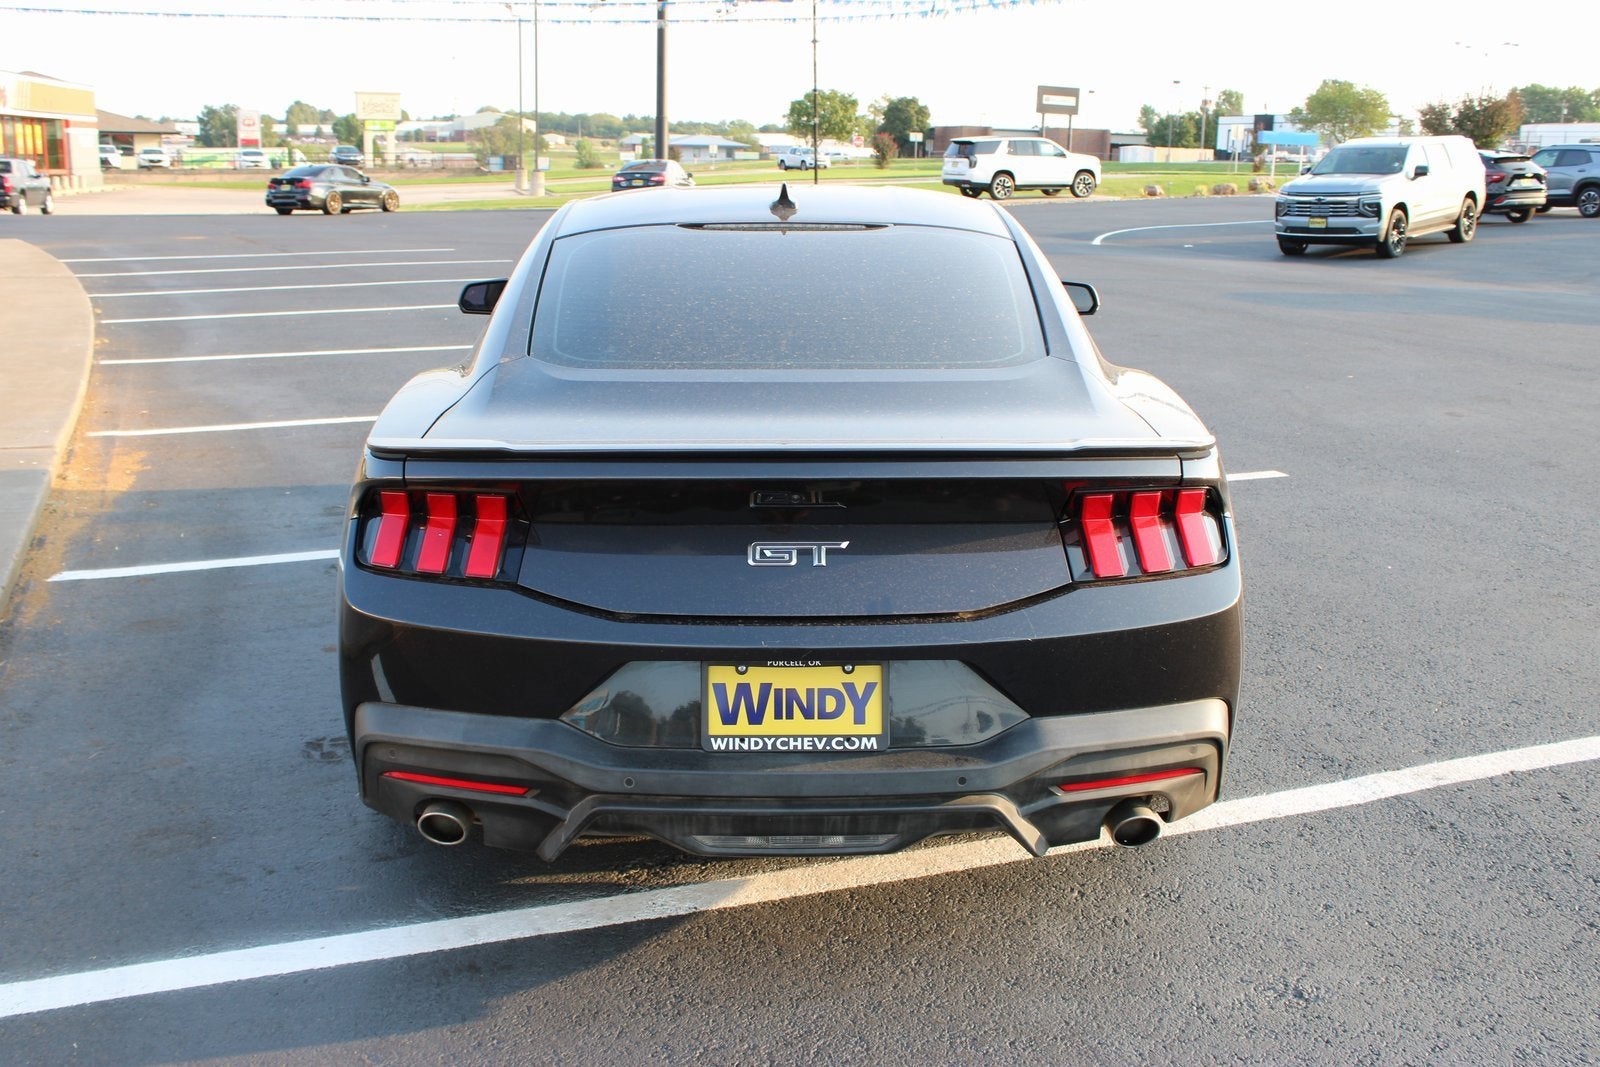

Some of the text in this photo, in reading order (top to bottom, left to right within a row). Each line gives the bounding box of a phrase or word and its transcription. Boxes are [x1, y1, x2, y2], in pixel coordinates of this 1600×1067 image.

[747, 541, 850, 566] GT
[711, 682, 879, 725] WINDY
[710, 737, 878, 750] WINDYCHEV.COM
